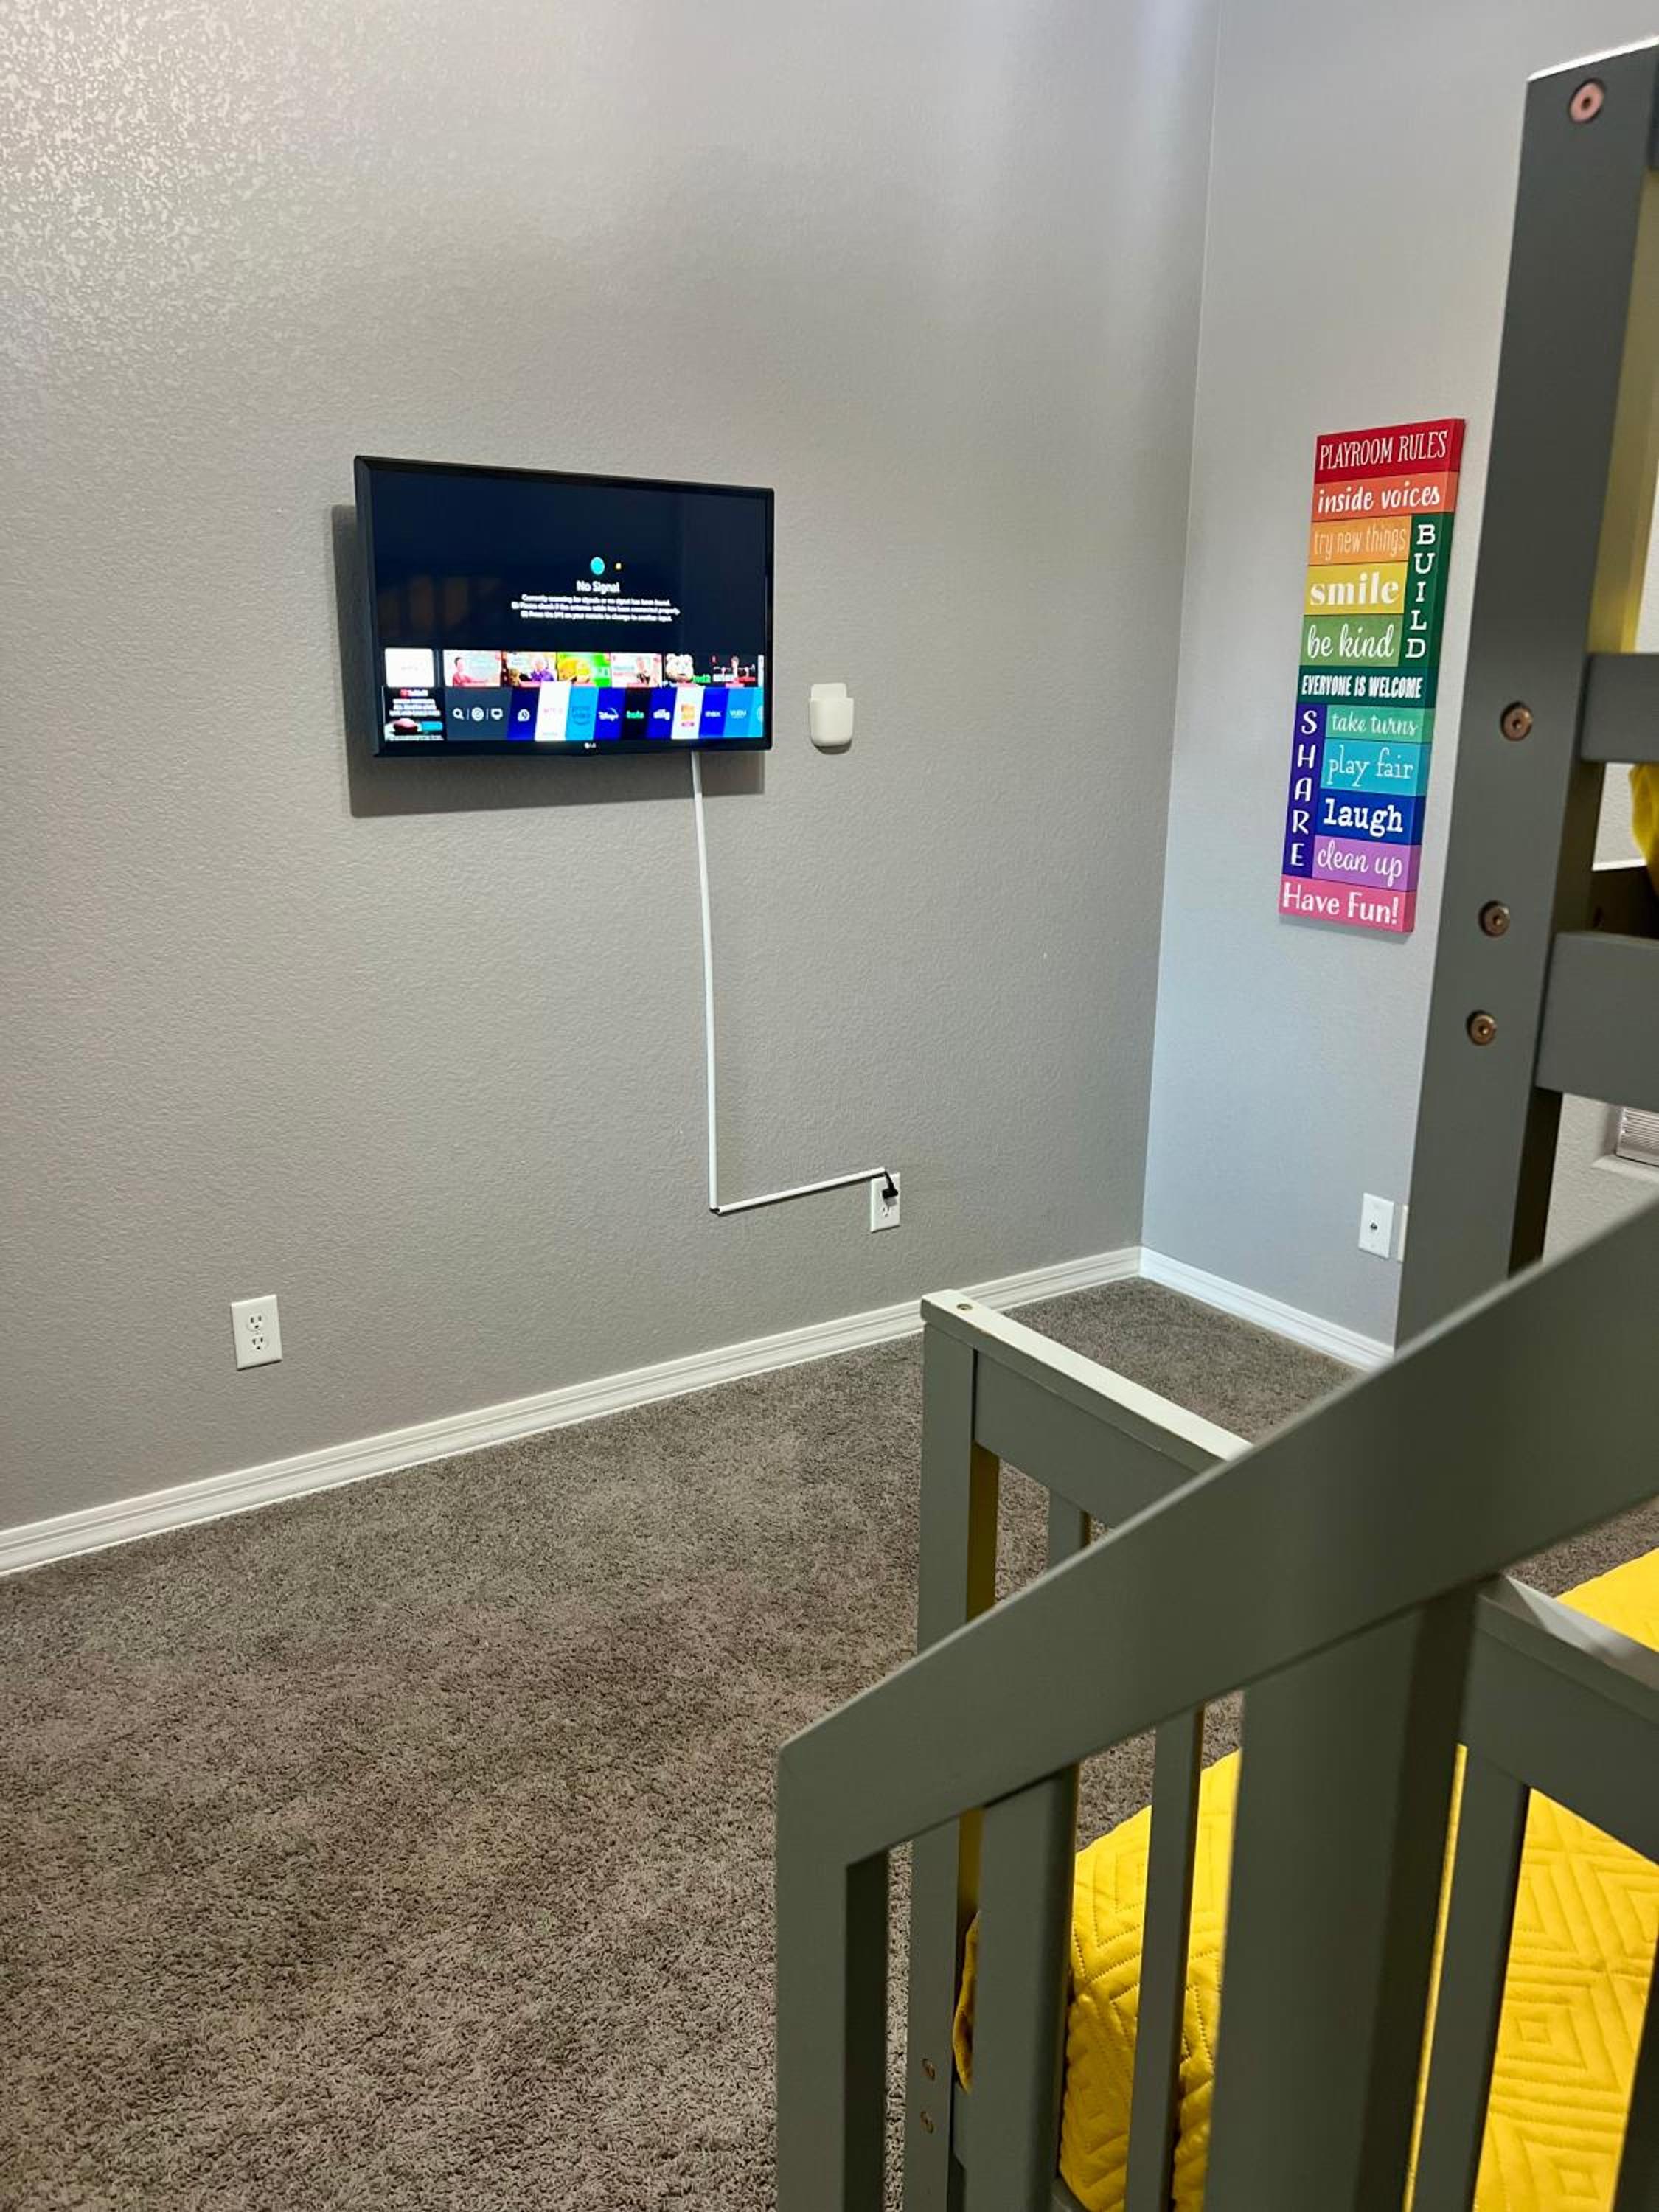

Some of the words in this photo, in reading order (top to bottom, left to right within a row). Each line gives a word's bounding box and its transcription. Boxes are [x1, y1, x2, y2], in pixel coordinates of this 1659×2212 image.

[1319, 437, 1392, 470] PLAYROOM
[1398, 430, 1448, 462] RULES
[1318, 486, 1374, 513] inside
[1381, 481, 1440, 509] voices
[1315, 532, 1332, 561] try
[1336, 531, 1361, 553] new
[1366, 524, 1405, 557] things
[576, 580, 591, 591] No
[592, 580, 620, 594] Signal
[1310, 571, 1399, 605] smile
[1405, 524, 1436, 658] BUILD
[1307, 625, 1333, 658] be
[1340, 623, 1394, 657] kind
[1301, 675, 1352, 696] EVERYONE
[1354, 677, 1366, 696] IS
[1368, 676, 1423, 699] WELCOME
[1332, 712, 1366, 732] take
[1370, 714, 1418, 736] turns
[1327, 745, 1370, 787] play
[1375, 747, 1413, 779] fair
[1290, 710, 1318, 867] SHARE
[1324, 798, 1403, 837] laugh
[1317, 840, 1369, 872] clean
[1375, 858, 1402, 886] up
[1282, 883, 1340, 915] Have
[1348, 892, 1399, 925] Fun!
